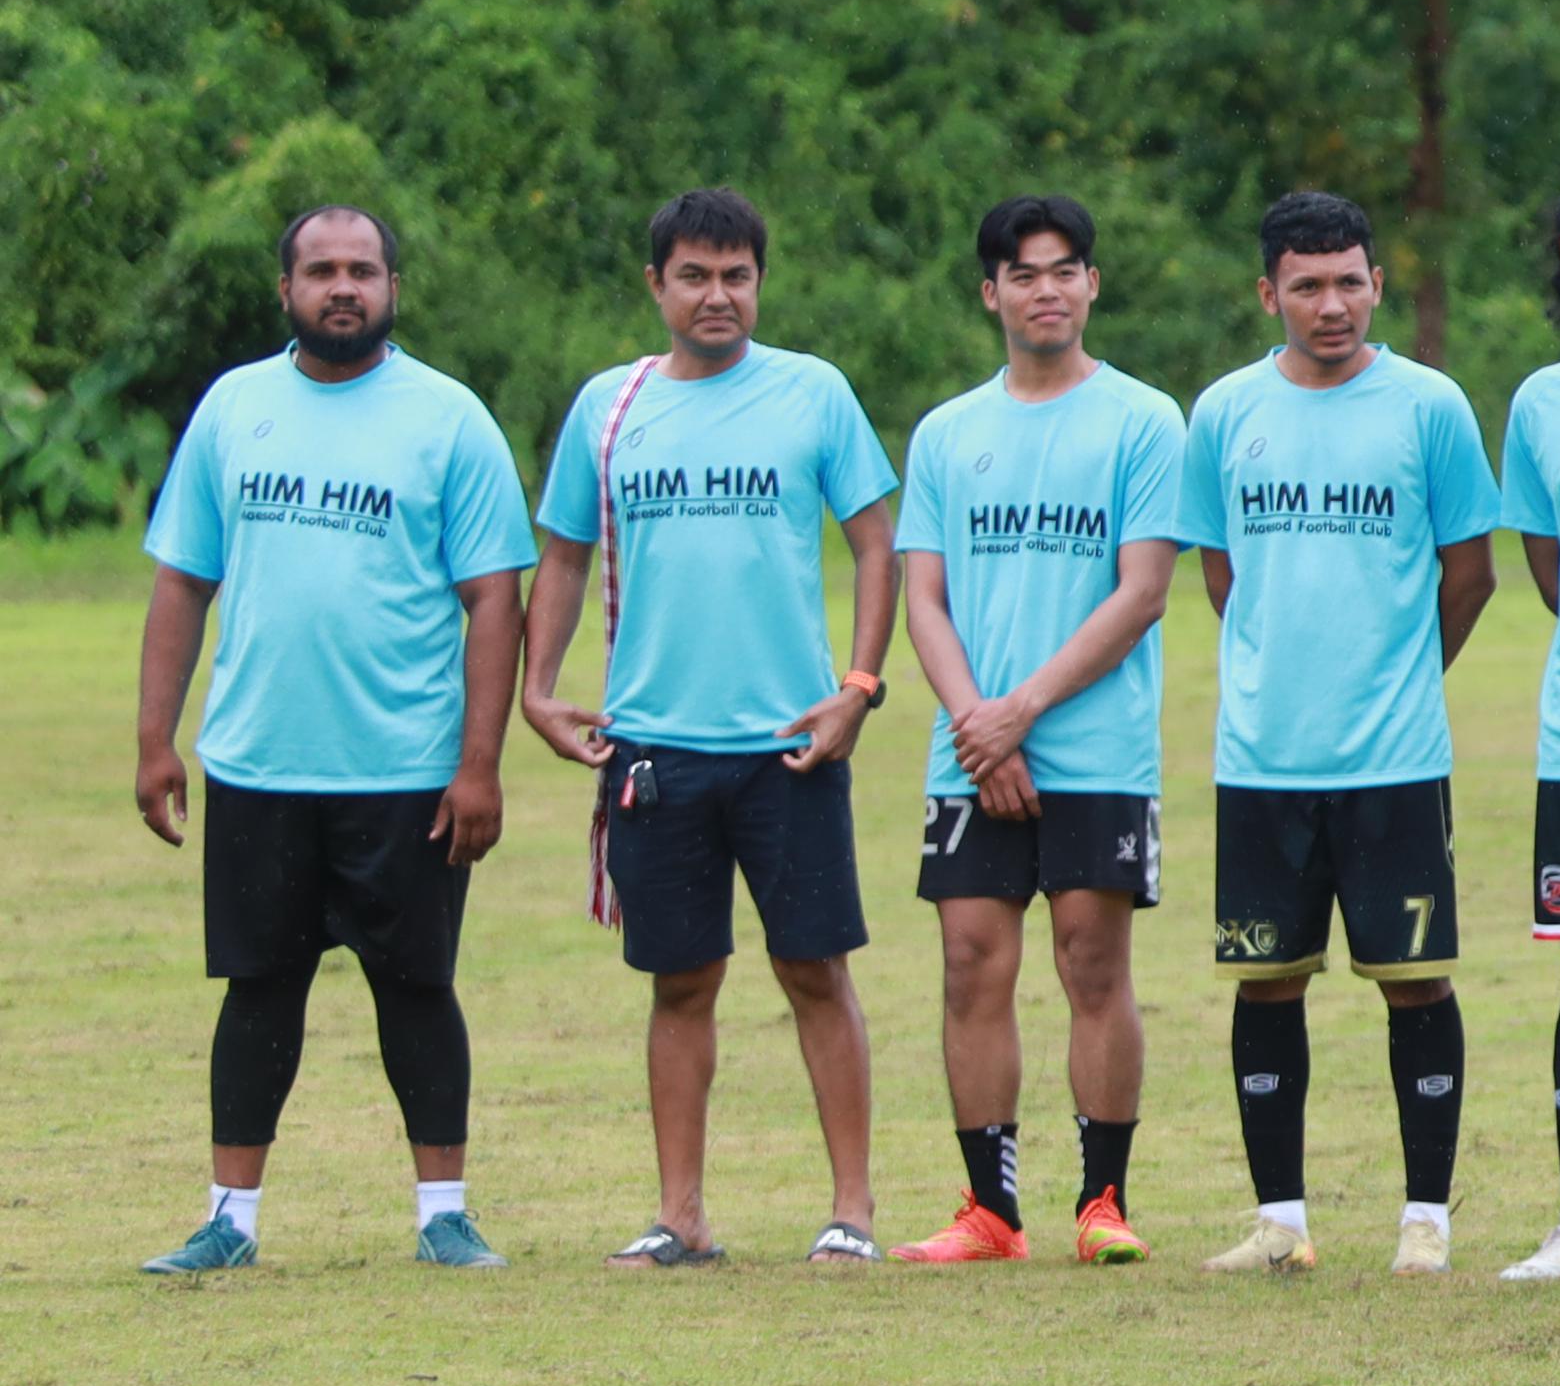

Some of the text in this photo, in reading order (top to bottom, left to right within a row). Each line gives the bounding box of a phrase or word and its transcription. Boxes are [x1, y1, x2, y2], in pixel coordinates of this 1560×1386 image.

[241, 472, 393, 519] HIM HIM
[620, 466, 779, 503] HIM HIM
[1241, 481, 1394, 517] HIM HIM
[290, 513, 350, 530] Football
[355, 521, 387, 537] Club
[745, 502, 778, 516] Club
[1038, 501, 1107, 539] HIM
[1298, 519, 1356, 534] Football
[1361, 522, 1393, 537] Club
[1072, 543, 1104, 558] Club
[1403, 894, 1435, 958] 7
